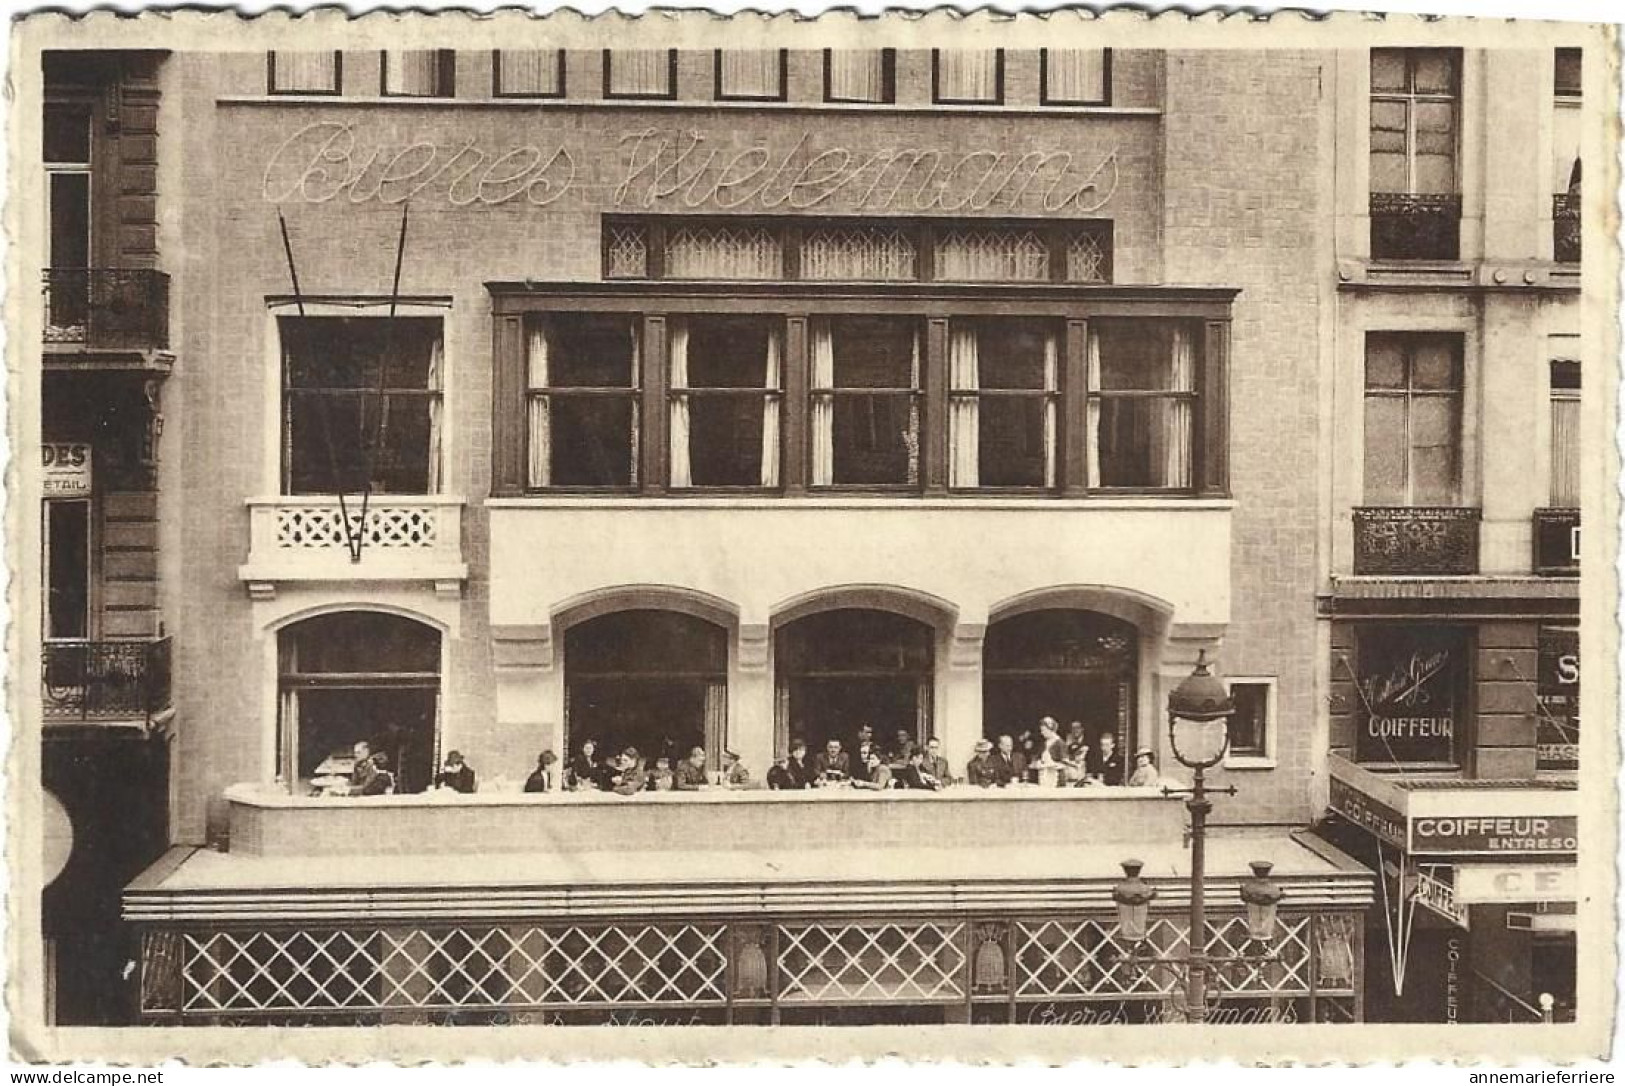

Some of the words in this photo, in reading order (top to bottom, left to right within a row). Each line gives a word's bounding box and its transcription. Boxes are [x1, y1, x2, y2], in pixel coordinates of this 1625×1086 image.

[614, 126, 1119, 212] Wielemans
[42, 445, 85, 466] DES
[43, 480, 86, 489] ETAIL
[1369, 717, 1454, 737] COIFFEUR
[1417, 819, 1549, 836] COIFFEUR
[1488, 838, 1576, 849] ENTRESO
